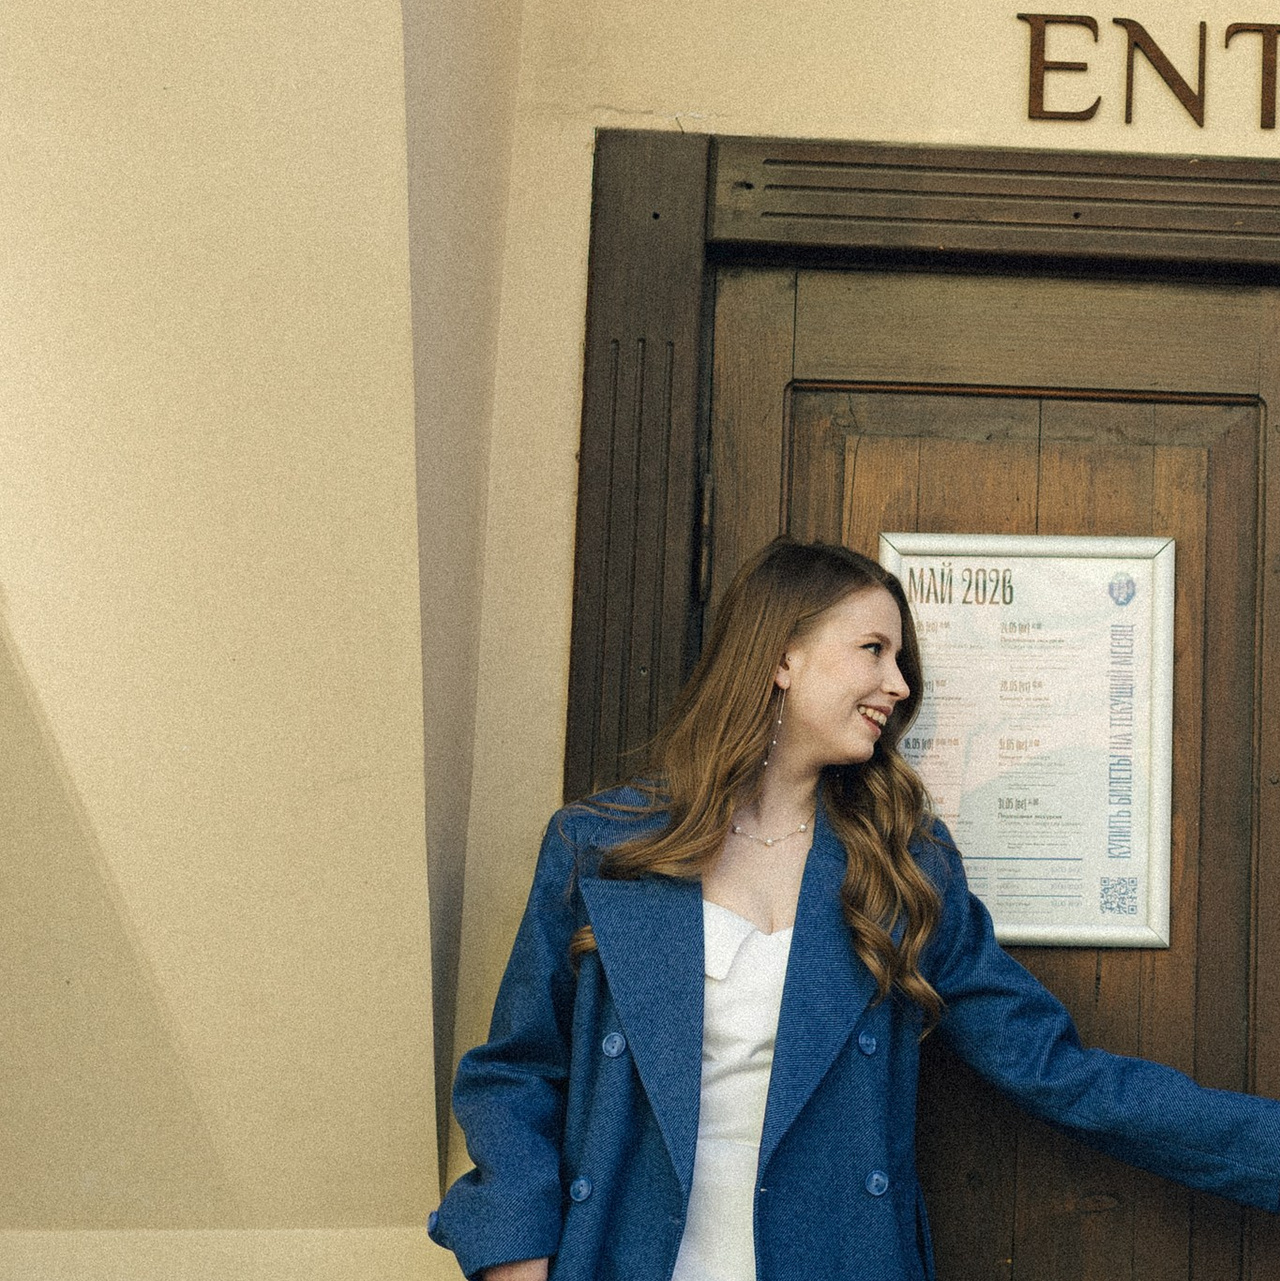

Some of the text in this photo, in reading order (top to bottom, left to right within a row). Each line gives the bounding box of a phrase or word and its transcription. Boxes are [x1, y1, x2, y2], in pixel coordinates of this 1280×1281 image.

[908, 561, 1014, 606] МАЙ 2026
[1105, 623, 1136, 860] КУПИТЬ БИЛЕТЫ НА ТЕКУЩИЙ МЕСЯЦ
